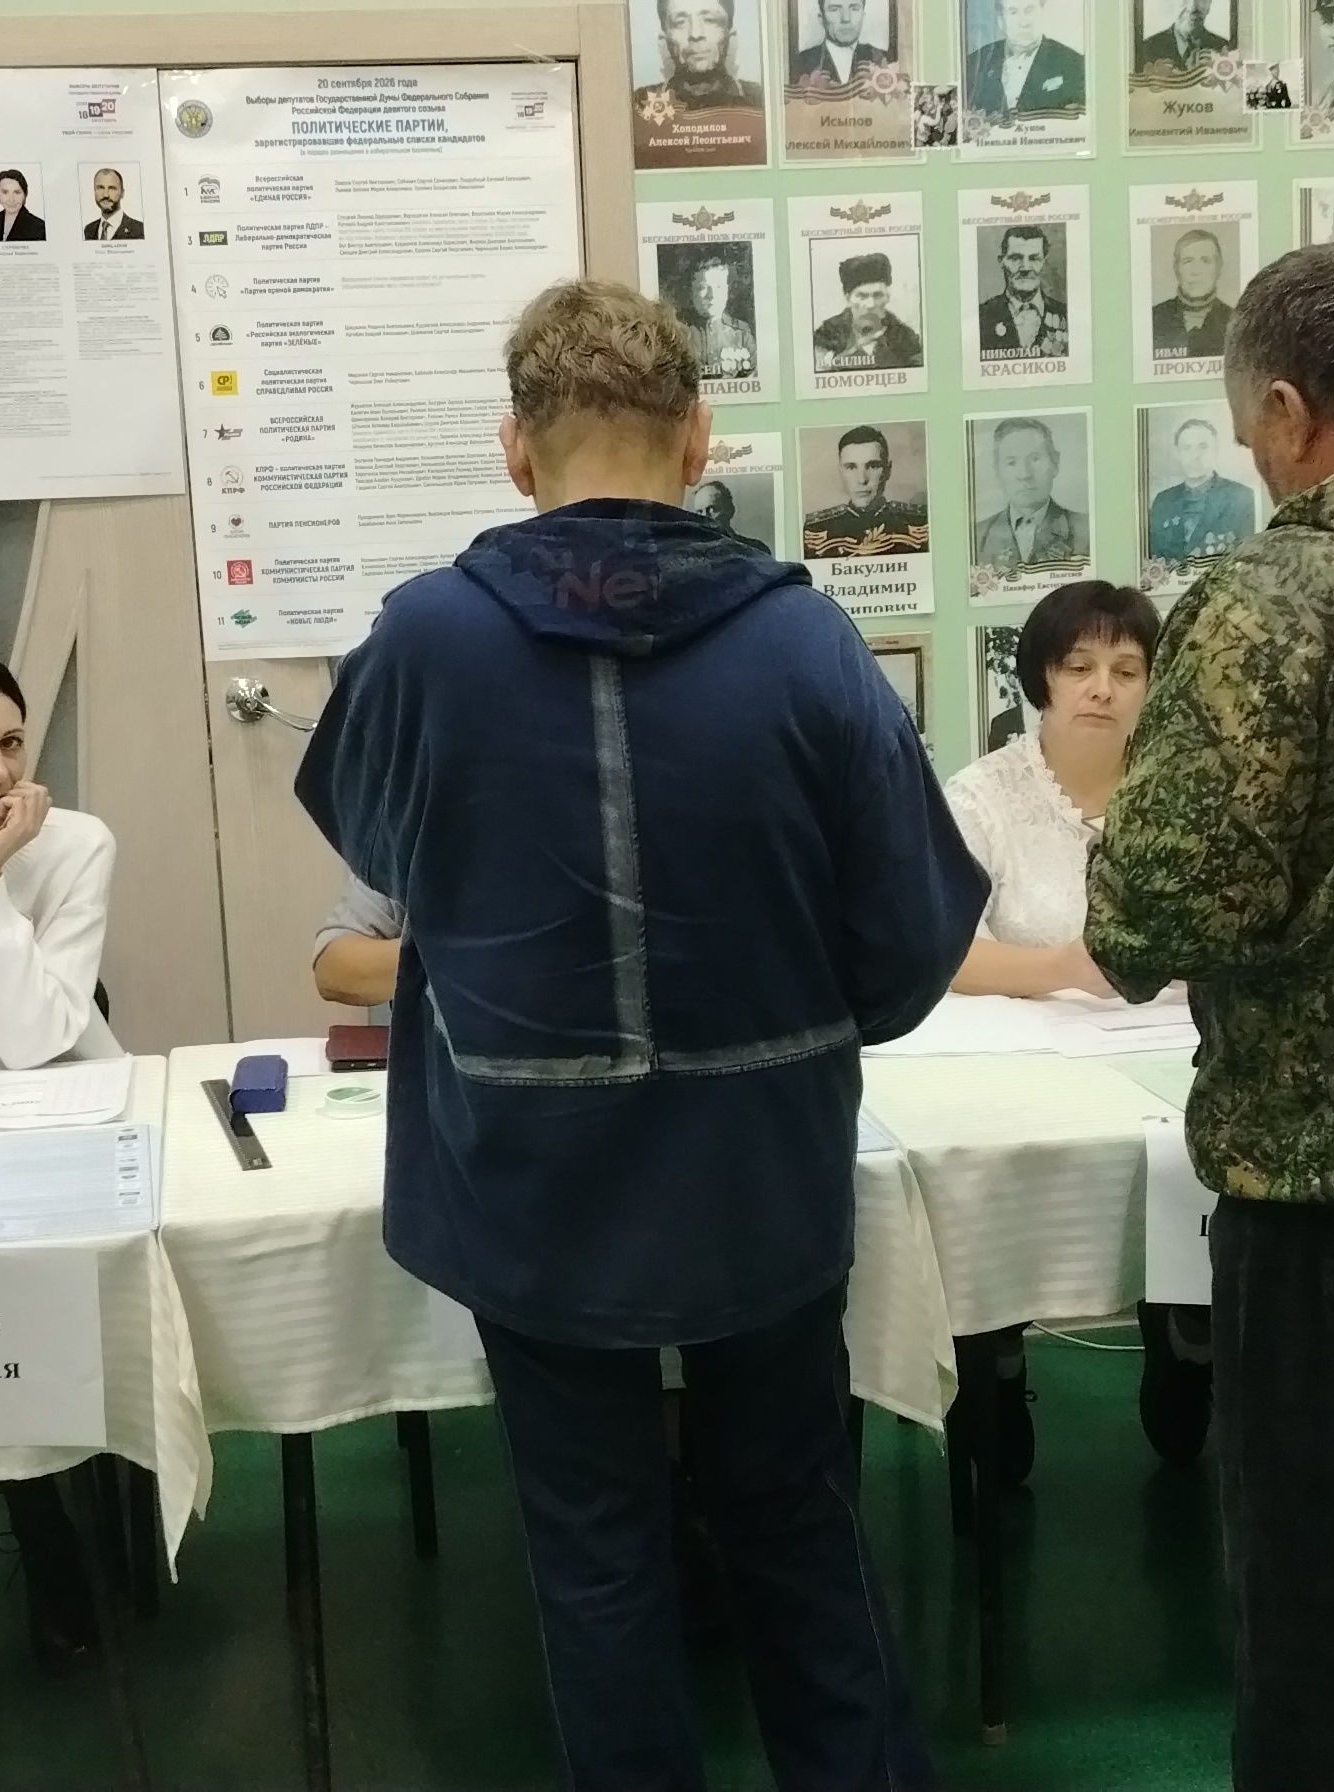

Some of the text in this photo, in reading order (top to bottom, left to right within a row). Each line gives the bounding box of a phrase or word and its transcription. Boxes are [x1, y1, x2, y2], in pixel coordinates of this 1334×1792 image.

[318, 78, 418, 89] 20 сентября 2026 года
[246, 96, 277, 105] Выборы
[278, 95, 315, 104] депутатов
[316, 94, 377, 104] Государственной
[401, 92, 453, 102] Федерального
[101, 102, 115, 110] 20
[292, 106, 336, 115] Российской
[338, 106, 381, 115] Федерации
[1163, 100, 1213, 116] Жуков
[292, 118, 449, 134] ПОЛИТИЧЕСКИЕ ПАРТИИ,
[820, 115, 873, 128] Исыпов
[672, 124, 727, 134] Холодилов
[1195, 126, 1248, 136] Иванович
[347, 136, 405, 147] федеральные
[649, 135, 751, 147] Алексей Леонтьевич
[203, 234, 225, 243] ЛДПР
[981, 347, 1041, 360] НИКОЛАЙ
[1155, 347, 1187, 358] ИВАН
[981, 360, 1067, 378] КРАСИКОВ
[199, 381, 205, 390] 6
[815, 372, 907, 390] ПОМОРЦЕВ
[698, 380, 761, 396] ЕПАНОВ
[270, 416, 323, 424] ВСЕРОССИЙСКАЯ
[260, 426, 309, 434] ПОЛИТИЧЕСКАЯ
[254, 474, 323, 482] КОММУНИСТИЧЕСКАЯ
[295, 520, 340, 528] ПЕНСИОНЕРОВ
[275, 558, 318, 566] Политическая
[261, 566, 329, 575] КОММУНИСТИЧЕСКАЯ
[831, 561, 909, 577] Бакулин
[213, 571, 221, 580] 10
[273, 576, 318, 584] КОММУНИСТЫ
[823, 581, 917, 598] Владимир
[842, 603, 917, 614] сипович
[218, 617, 225, 625] 11
